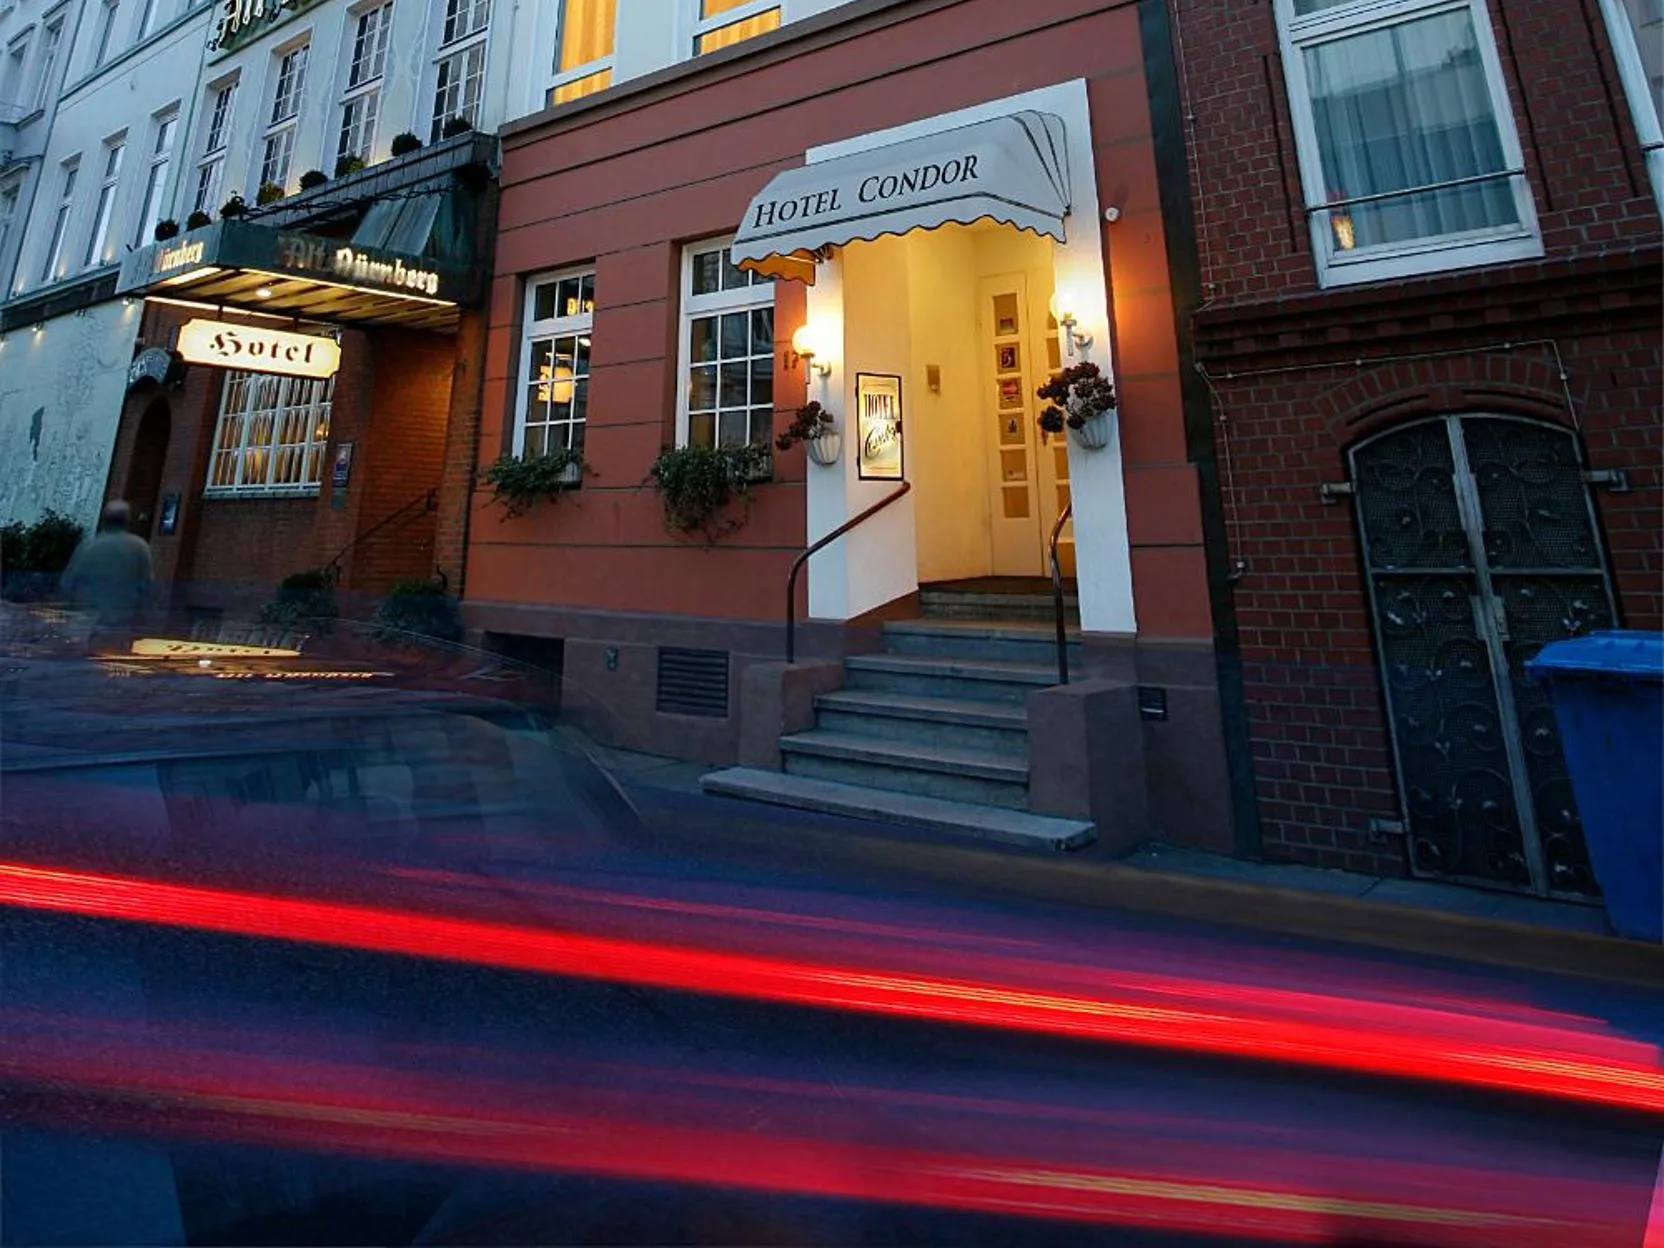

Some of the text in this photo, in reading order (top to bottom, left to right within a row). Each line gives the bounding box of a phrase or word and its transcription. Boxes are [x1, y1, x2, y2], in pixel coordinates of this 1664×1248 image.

[752, 154, 979, 229] HOTEL CONDOR
[333, 246, 439, 296] Nürnberg
[209, 330, 314, 364] Hotel
